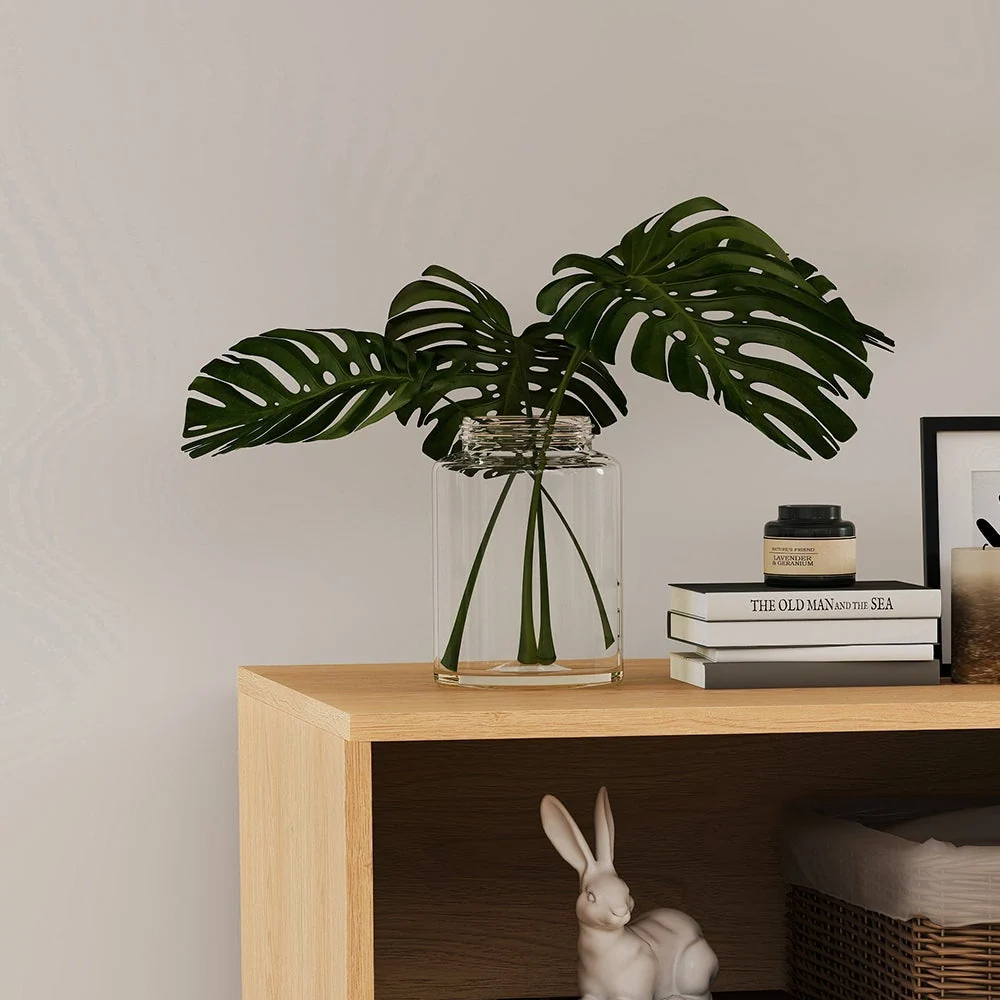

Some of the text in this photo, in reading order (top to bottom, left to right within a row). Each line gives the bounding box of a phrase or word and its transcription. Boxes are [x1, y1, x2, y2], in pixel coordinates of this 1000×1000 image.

[750, 597, 894, 612] THE OLD MAN AND THE SEA
